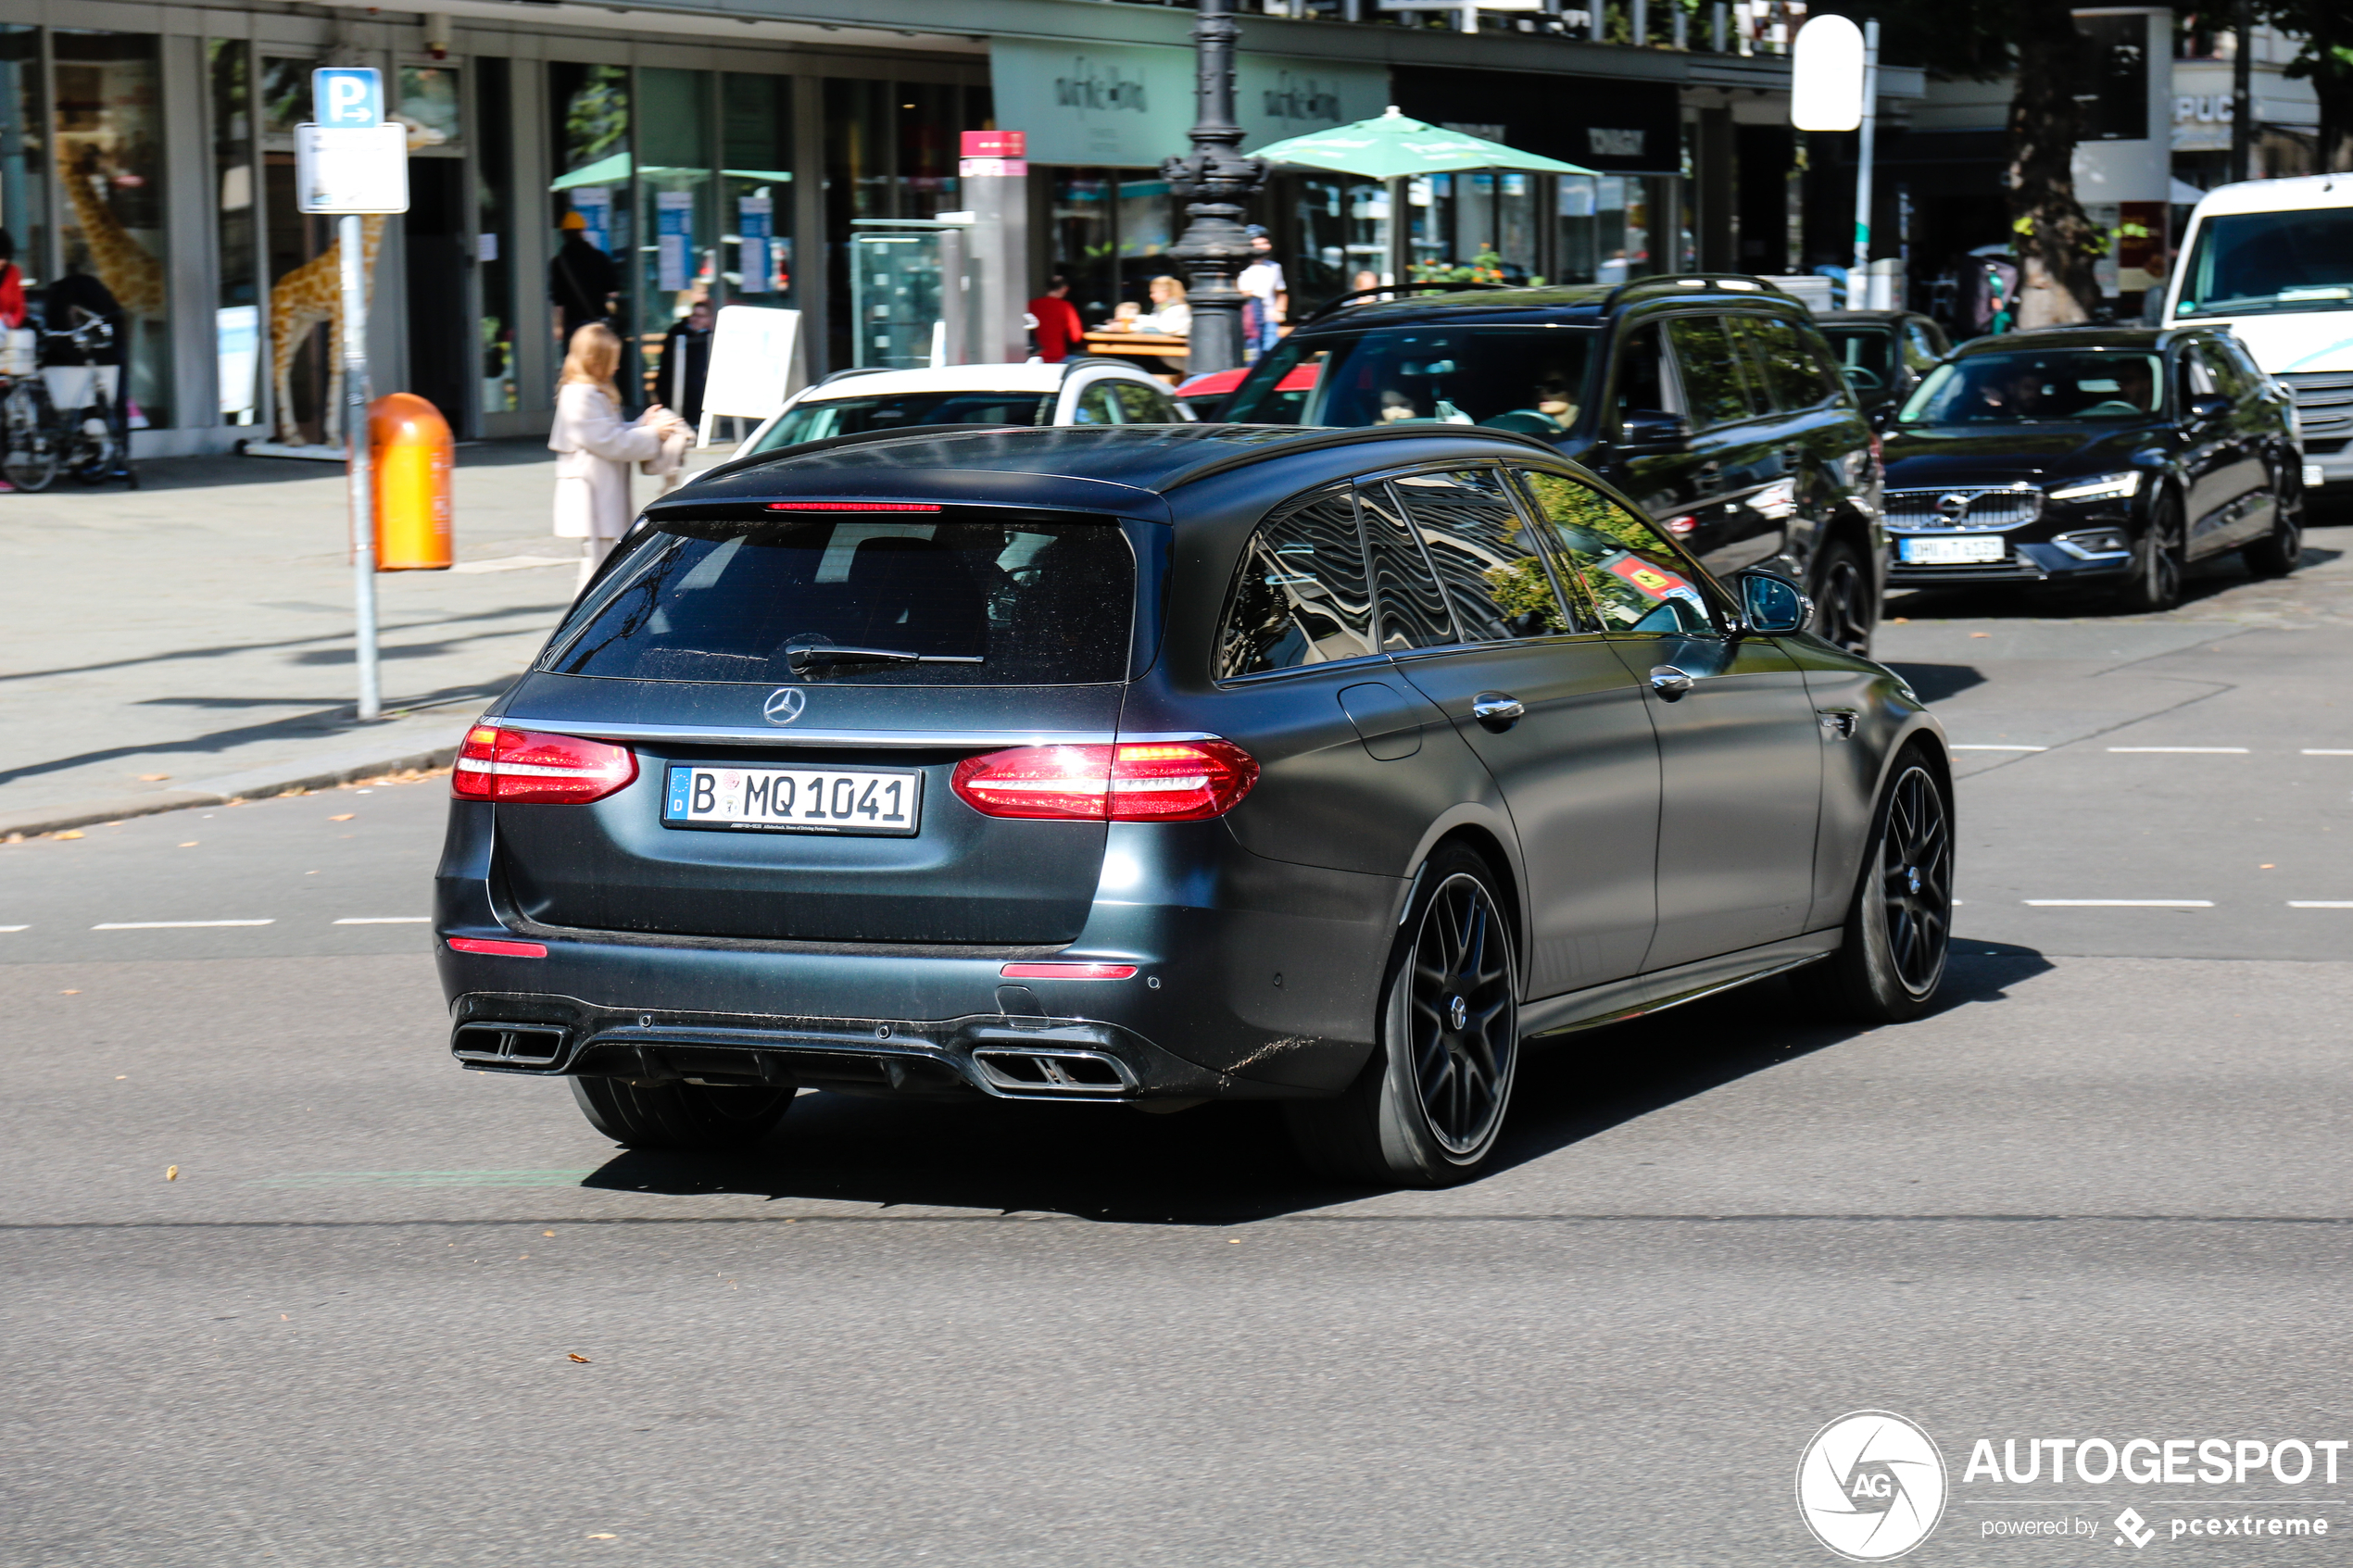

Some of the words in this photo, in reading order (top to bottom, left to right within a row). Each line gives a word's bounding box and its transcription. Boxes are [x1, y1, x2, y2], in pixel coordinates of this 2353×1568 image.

[328, 76, 367, 122] P
[673, 799, 683, 812] D
[693, 773, 716, 813] B
[744, 775, 796, 818] MQ
[805, 777, 905, 822] 1041
